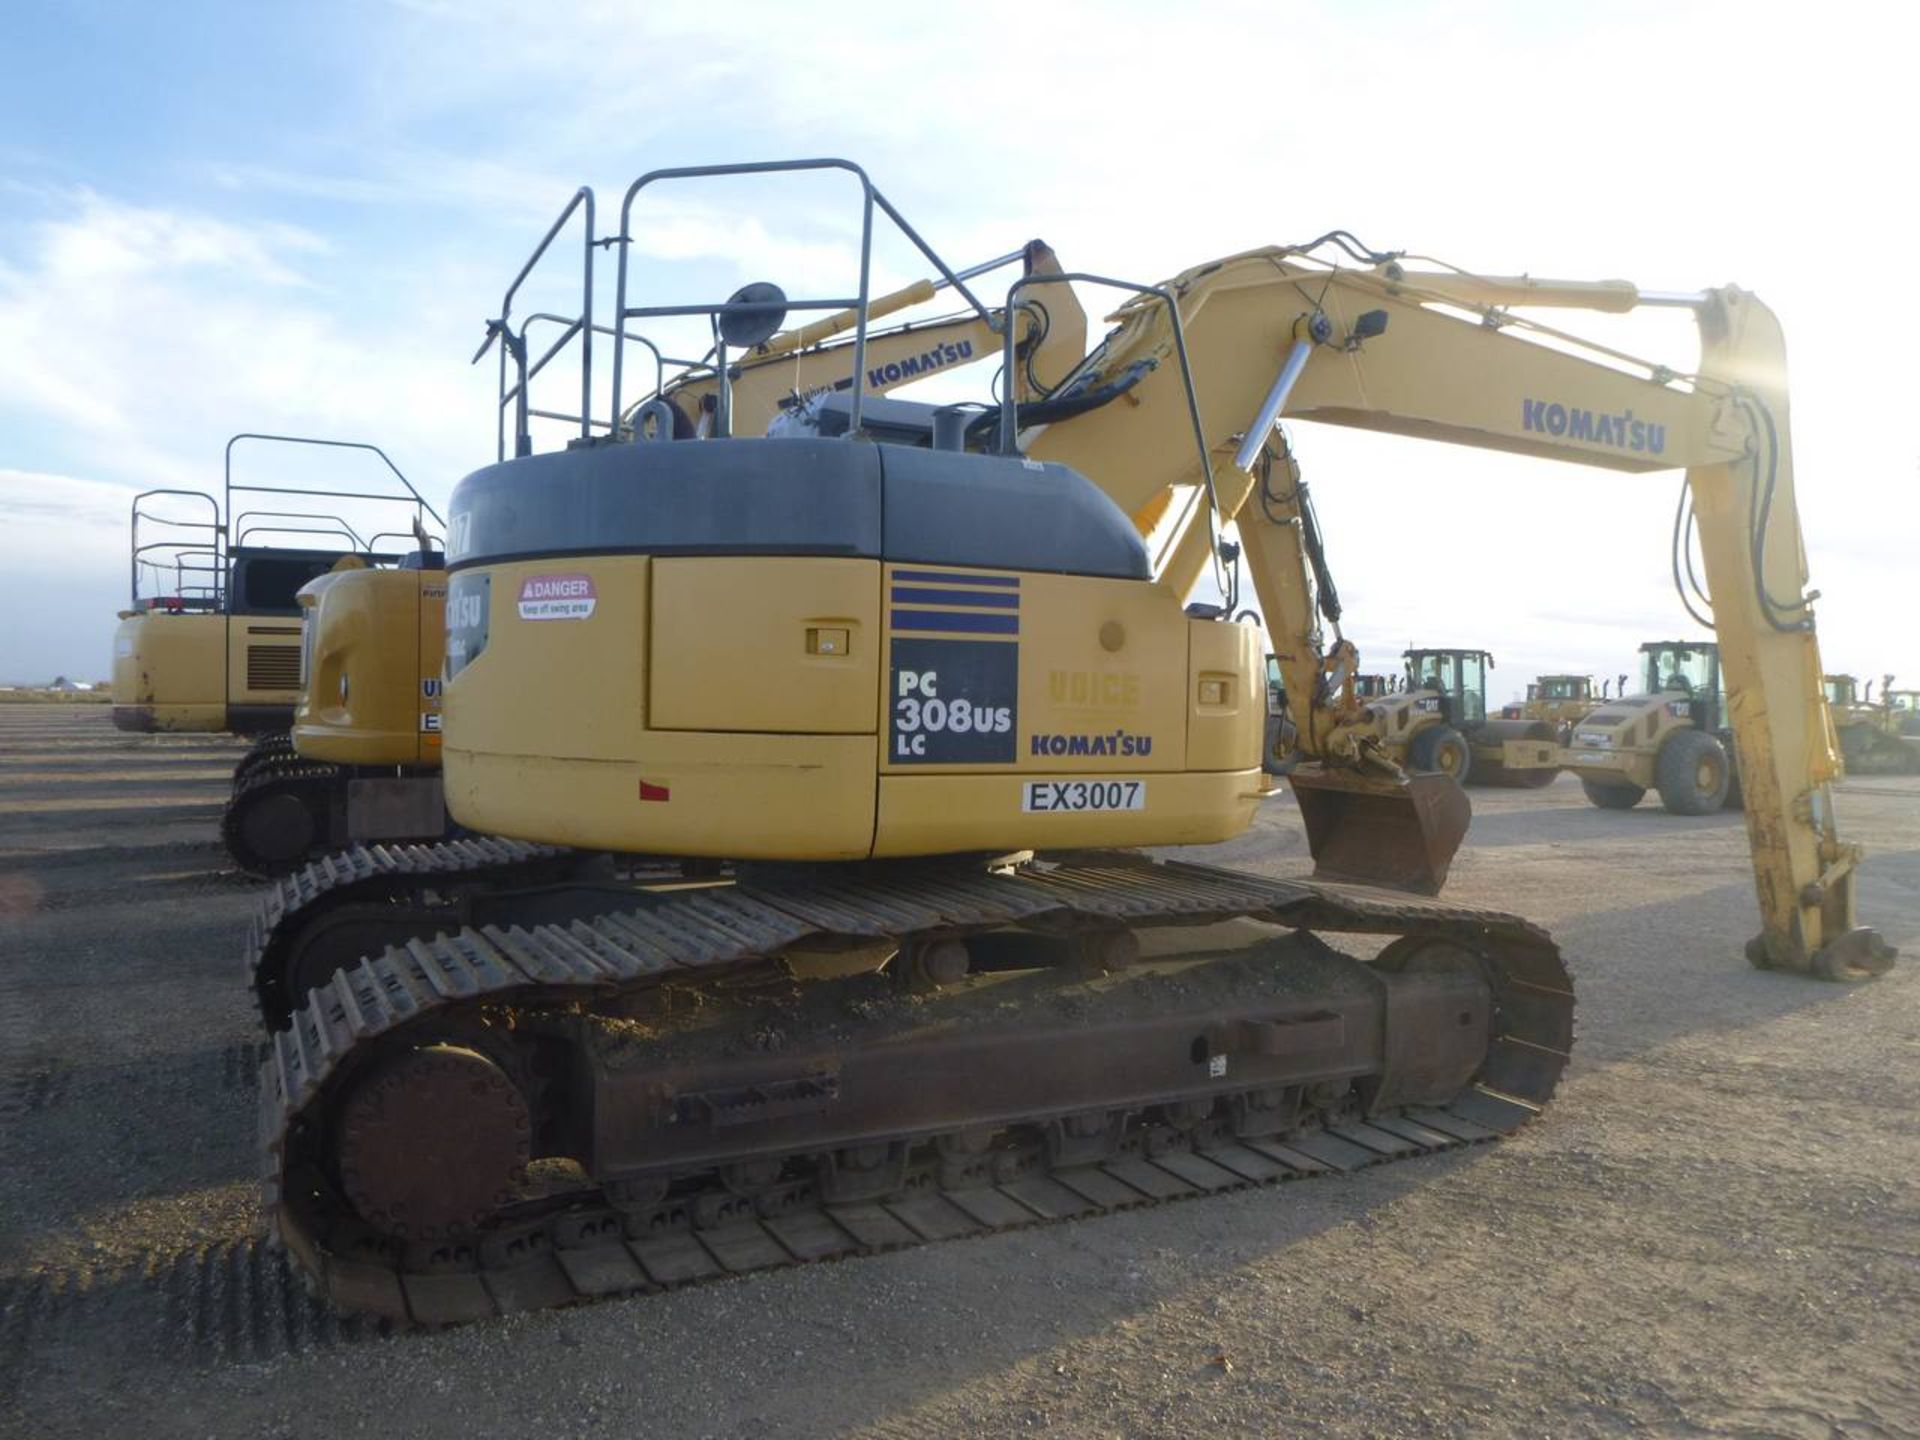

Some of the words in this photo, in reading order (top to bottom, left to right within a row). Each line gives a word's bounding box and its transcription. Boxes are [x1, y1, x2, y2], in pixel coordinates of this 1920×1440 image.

[867, 340, 973, 388] KOMATSU
[1523, 399, 1666, 455] KOMATSU
[534, 581, 589, 598] DANGER
[898, 671, 937, 697] PC
[897, 734, 926, 755] LC
[1031, 729, 1152, 756] KOMATSU
[1030, 782, 1140, 811] EX3007
